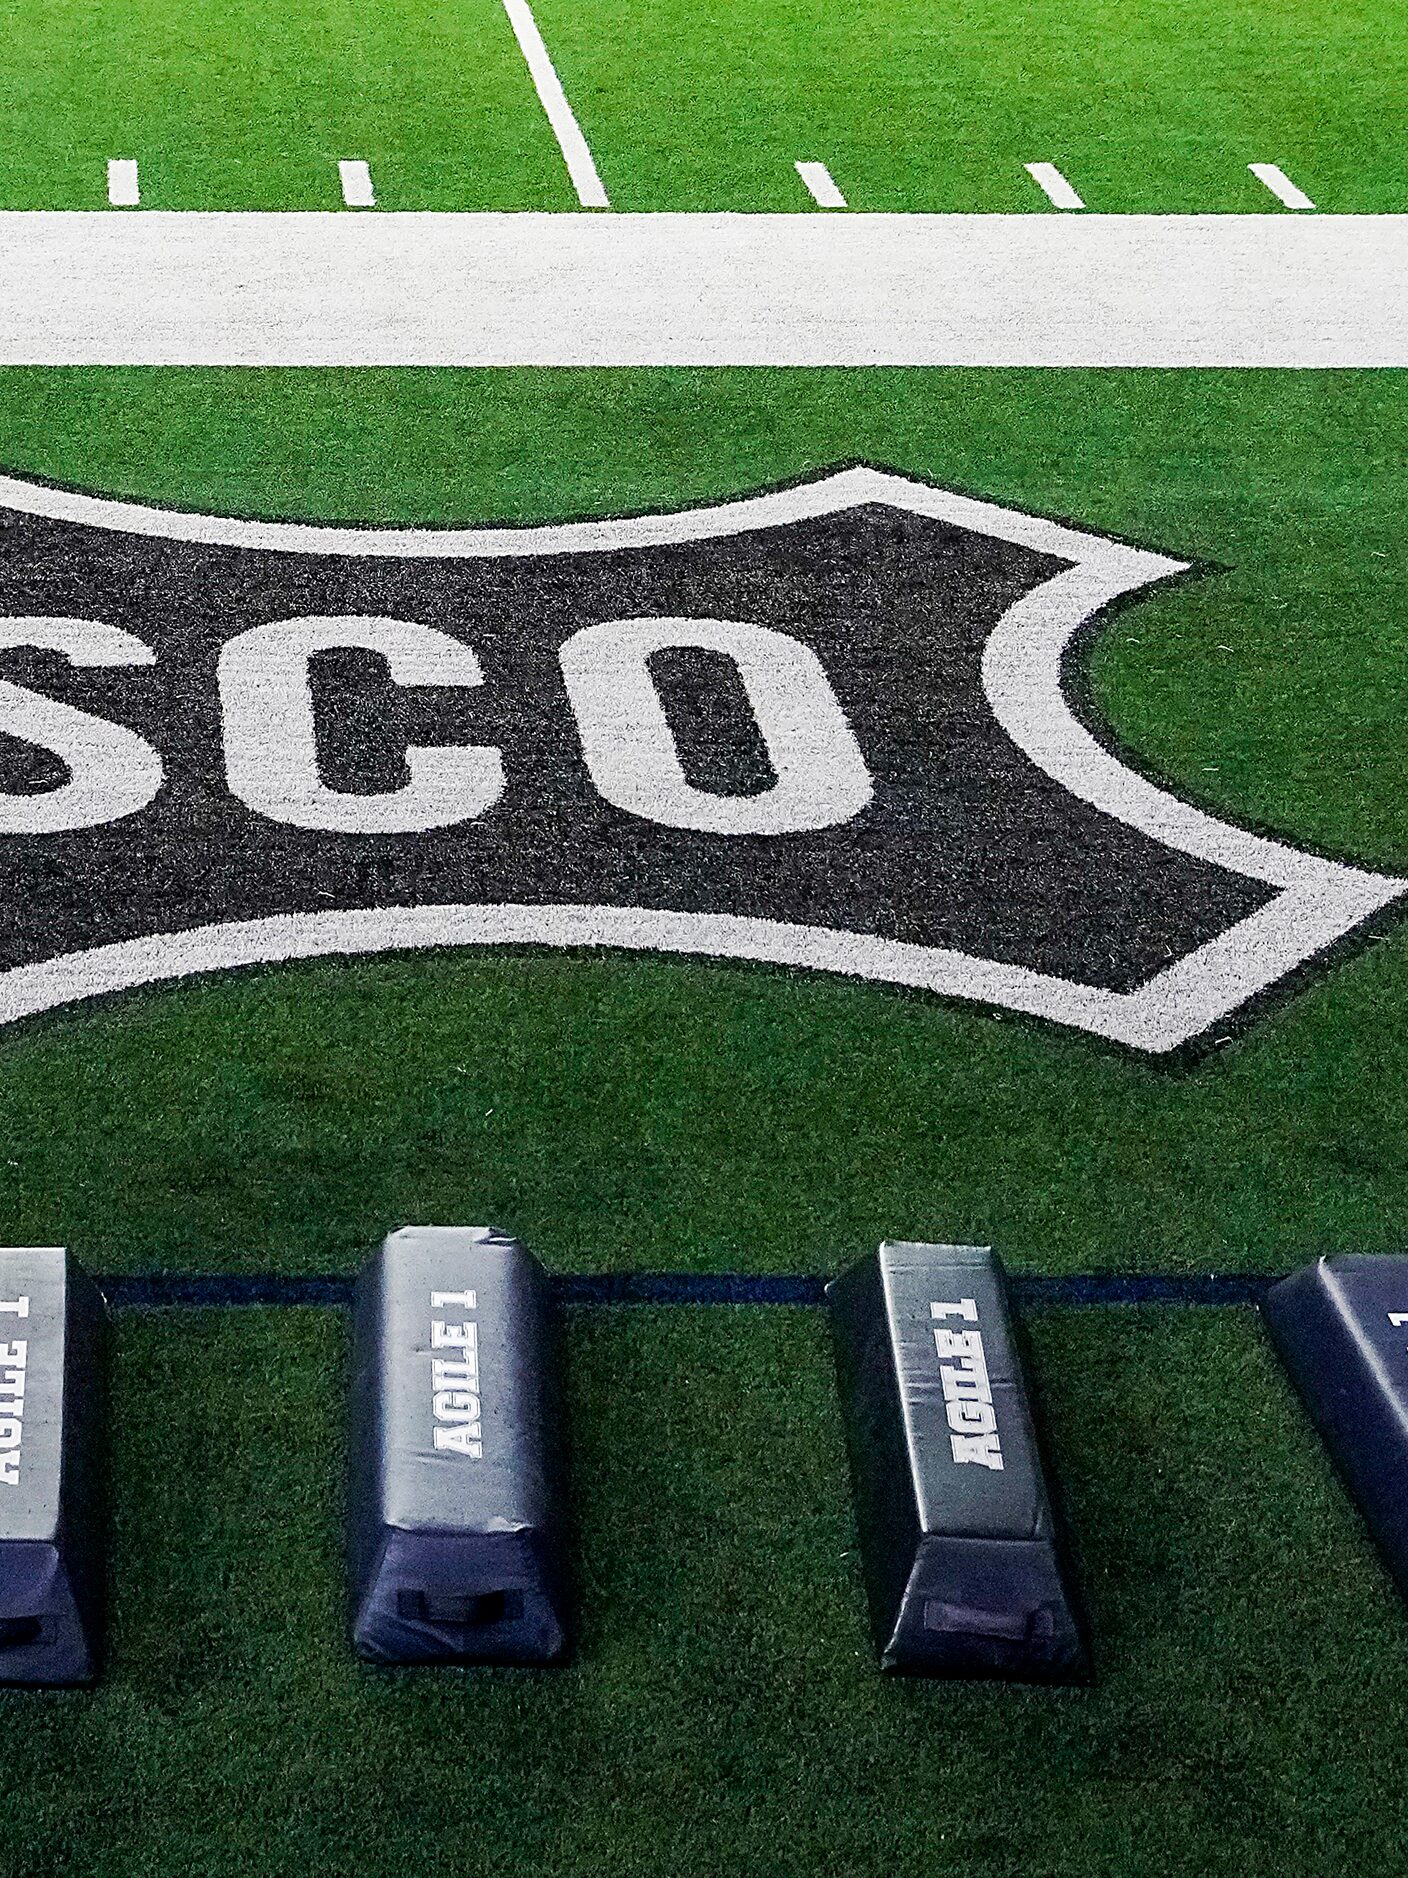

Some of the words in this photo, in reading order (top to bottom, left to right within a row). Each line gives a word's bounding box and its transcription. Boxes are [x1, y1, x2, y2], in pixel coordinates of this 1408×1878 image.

[429, 1288, 479, 1310] 1
[929, 1297, 979, 1322] 1
[430, 1319, 484, 1460] AGILE
[932, 1328, 1005, 1471] AGILE
